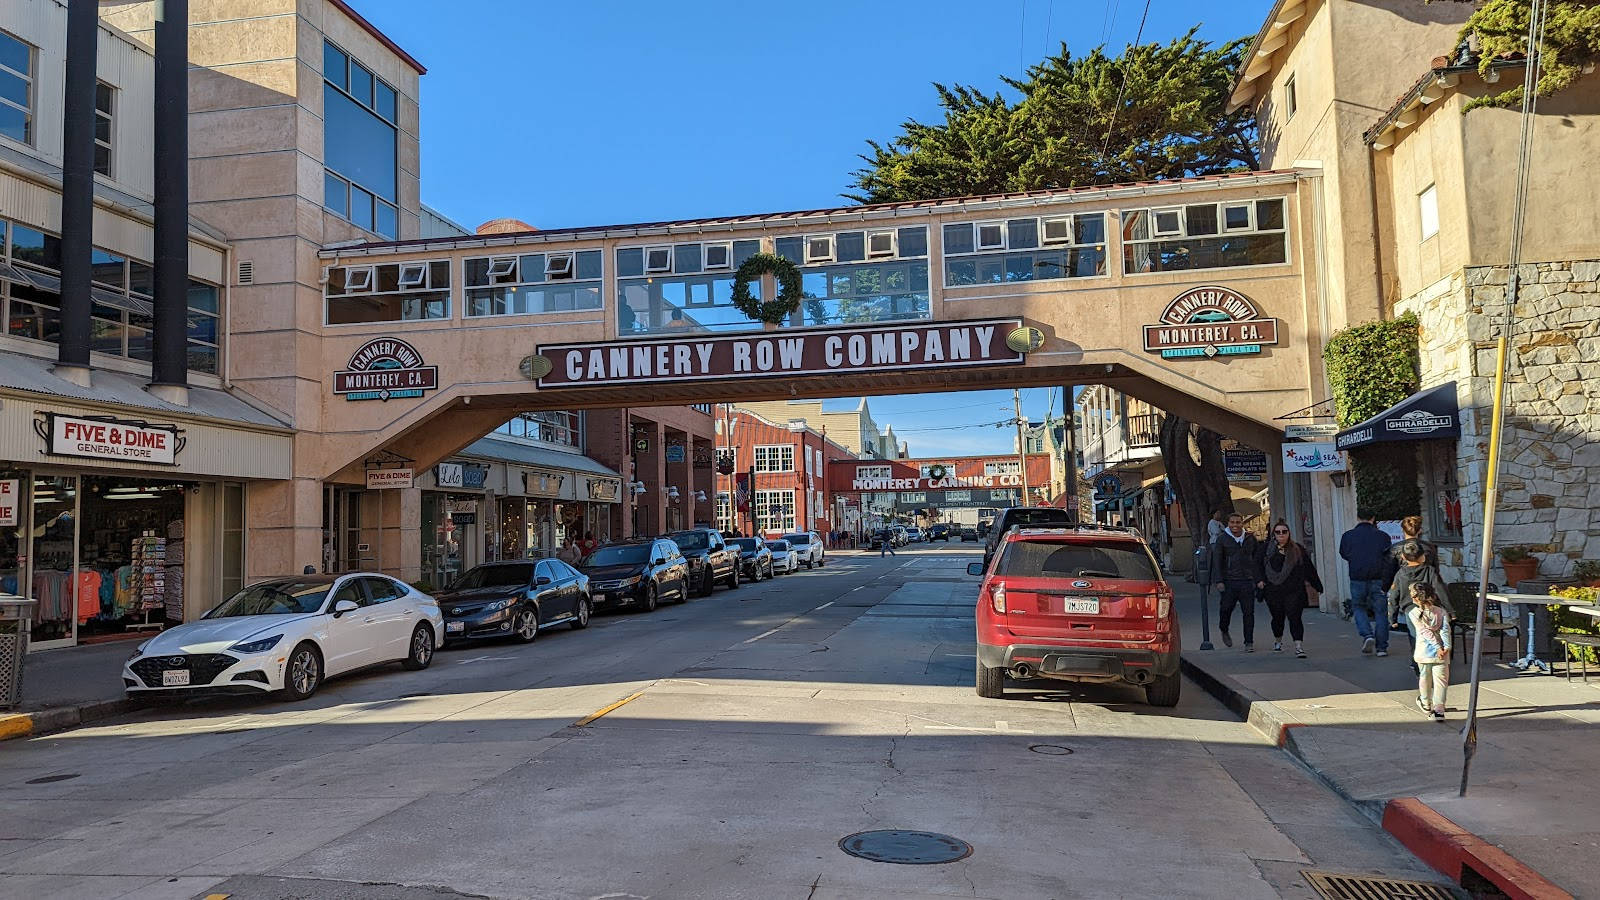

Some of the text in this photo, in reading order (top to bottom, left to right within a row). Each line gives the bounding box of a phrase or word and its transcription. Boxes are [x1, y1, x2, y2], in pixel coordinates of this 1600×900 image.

[1169, 291, 1251, 322] CANNERY ROW
[1159, 325, 1263, 344] MONTEREY, CA.
[353, 342, 417, 370] CANNERY ROW
[566, 326, 995, 380] CANNERY ROW COMPANY
[345, 371, 426, 389] MONTEREY, CA.
[1389, 418, 1449, 428] GHIRARDELLI
[64, 422, 166, 449] FIVE & DIME
[1338, 428, 1373, 447] GHIRARDELLI
[77, 443, 151, 458] GENERAL STORE
[369, 472, 385, 480] FIVE
[853, 475, 1023, 490] MONTEREY CANNING CO.
